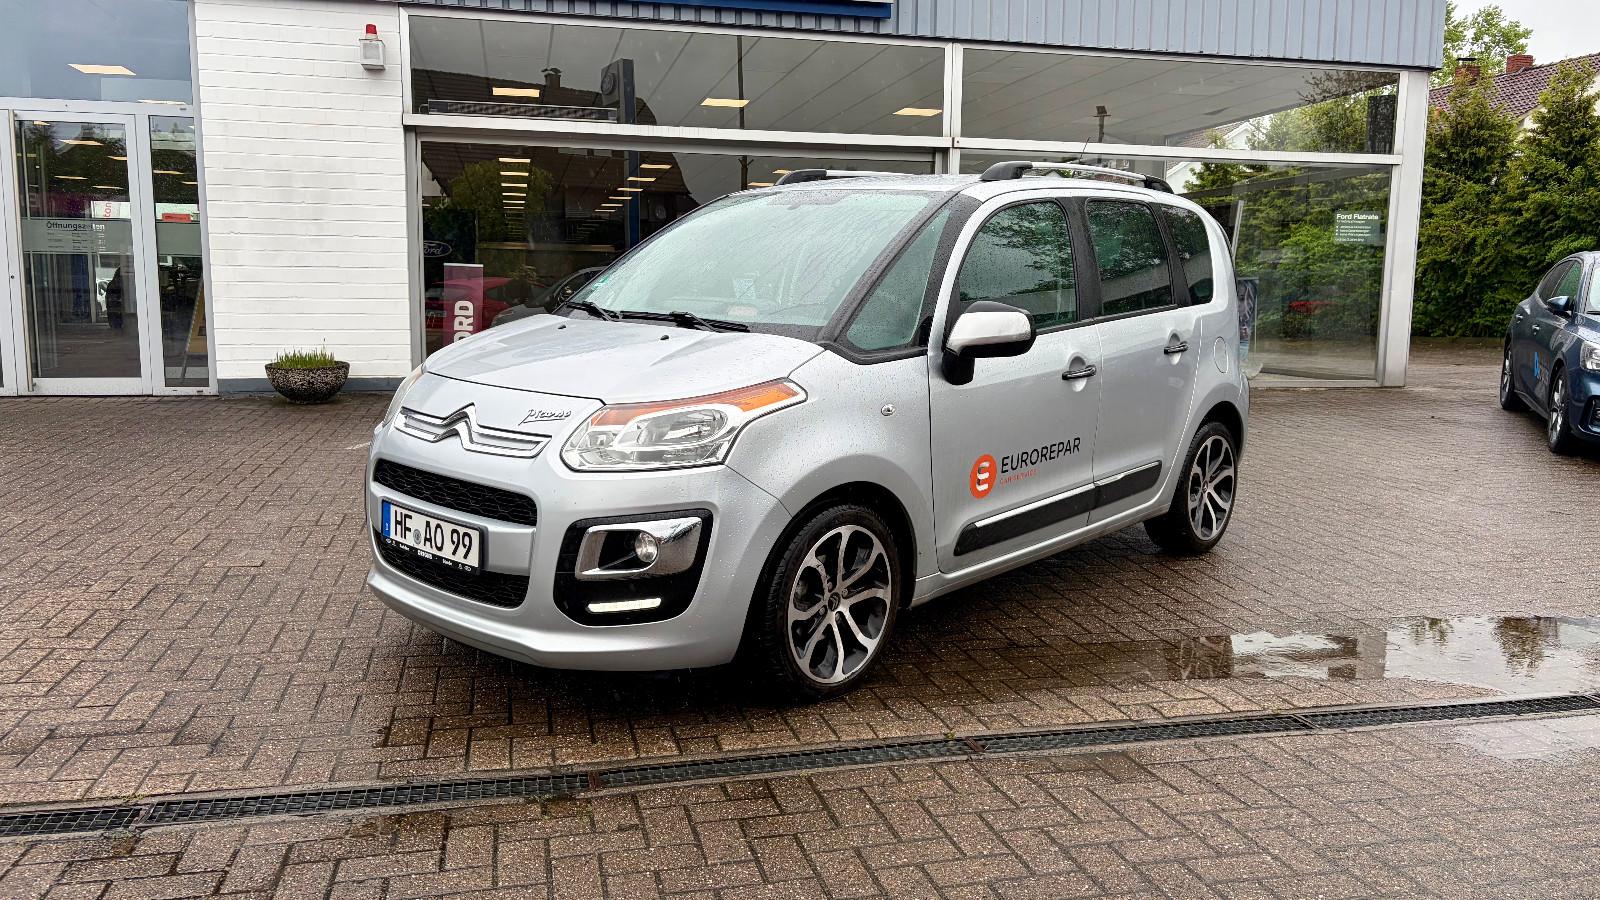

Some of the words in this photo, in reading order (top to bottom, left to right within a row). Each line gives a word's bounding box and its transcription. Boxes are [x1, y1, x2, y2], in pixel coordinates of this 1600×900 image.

[1001, 437, 1081, 473] EUROREPAR
[394, 509, 413, 540] HF
[423, 520, 445, 552] AO
[450, 528, 473, 560] 99
